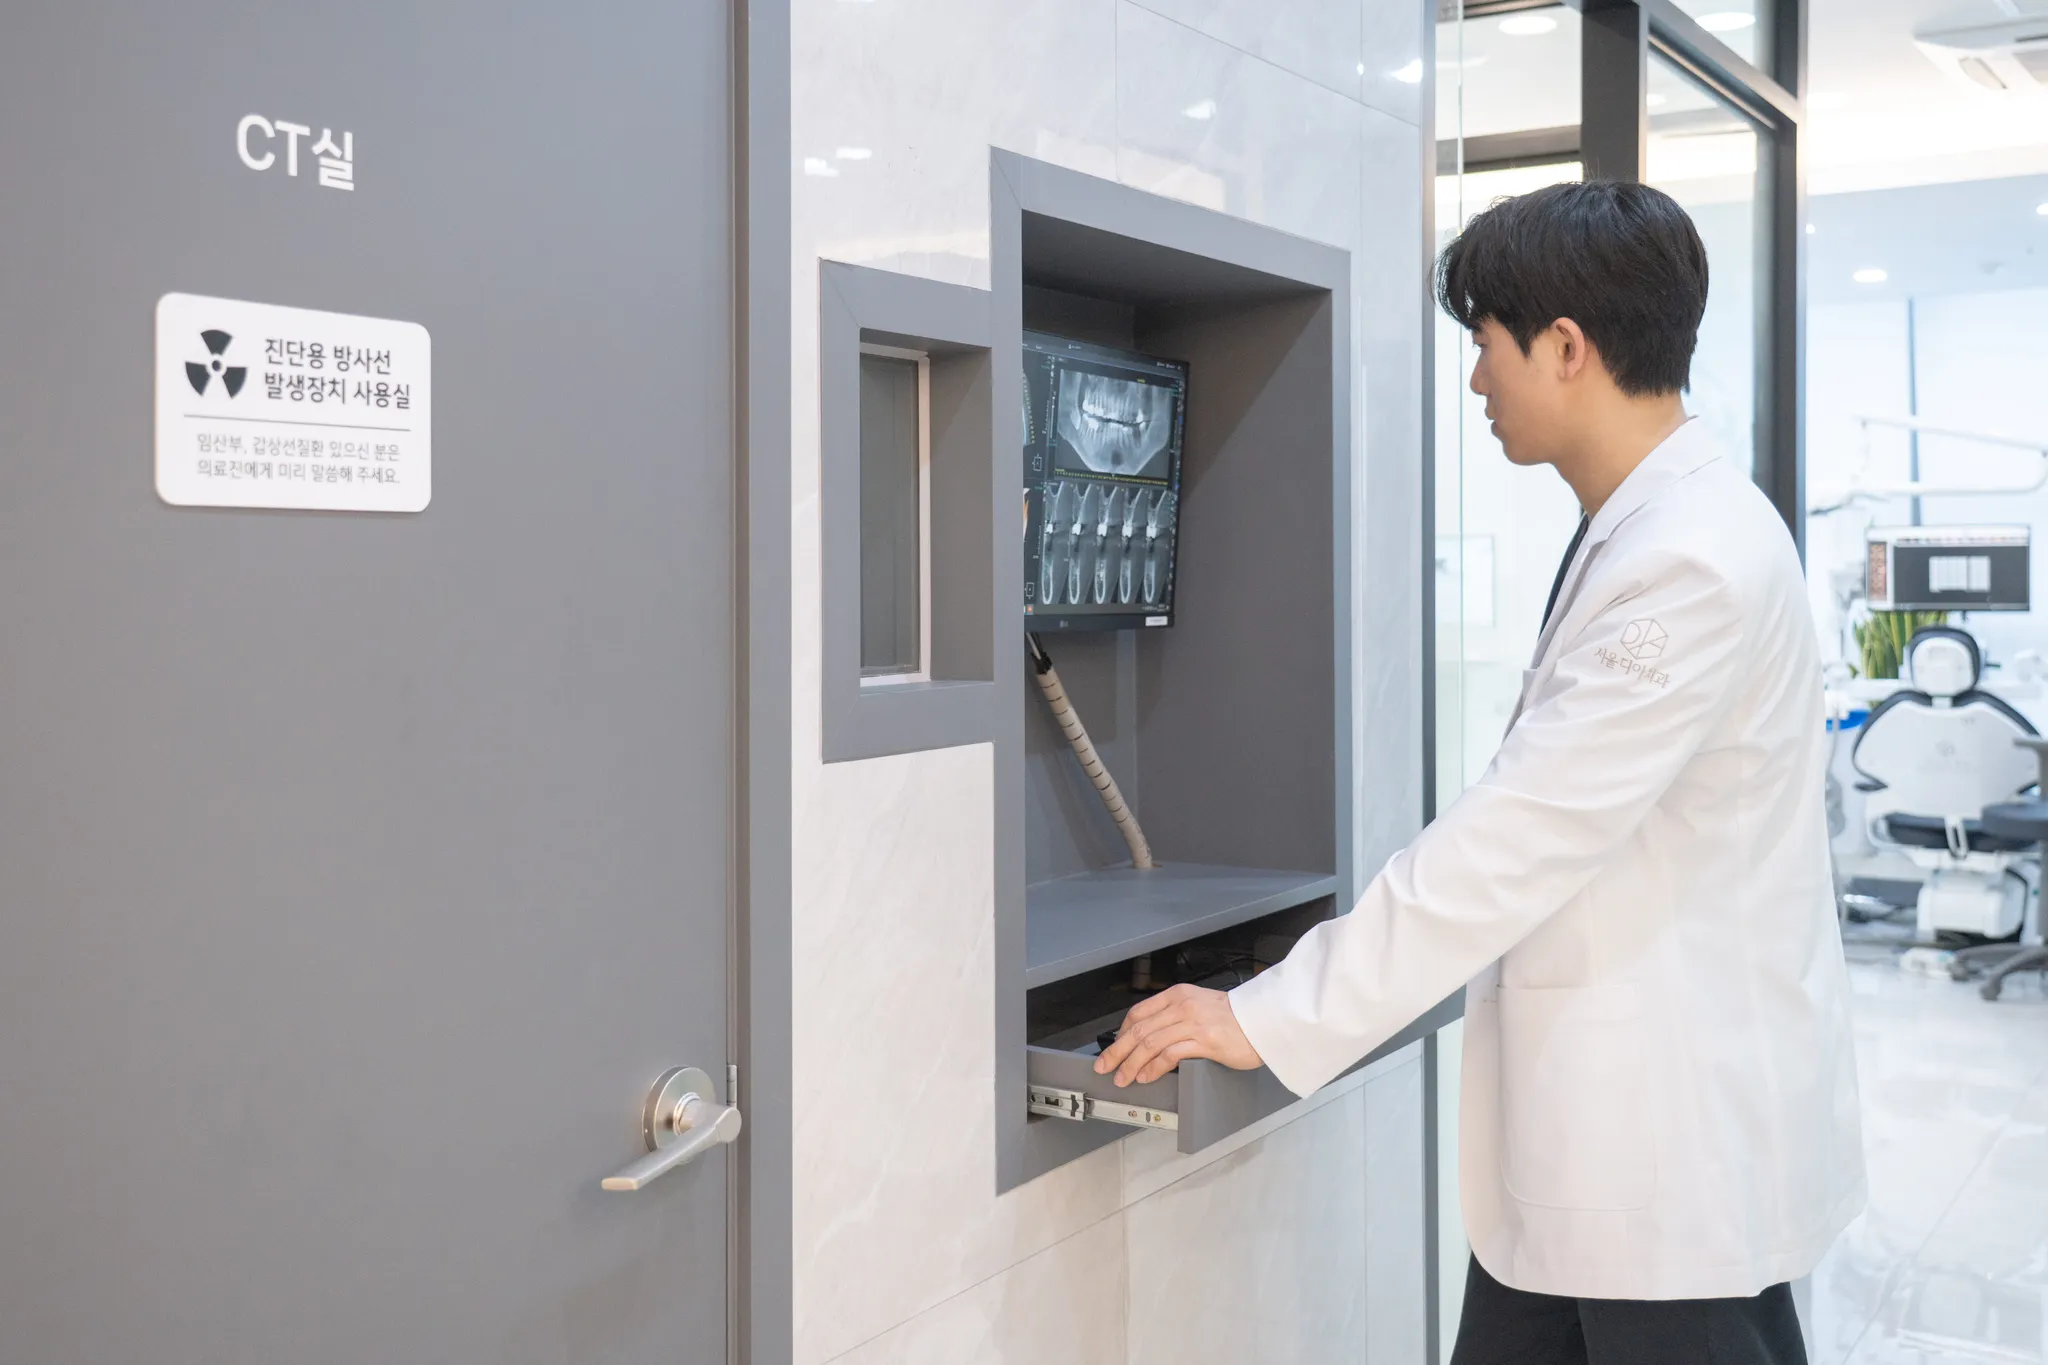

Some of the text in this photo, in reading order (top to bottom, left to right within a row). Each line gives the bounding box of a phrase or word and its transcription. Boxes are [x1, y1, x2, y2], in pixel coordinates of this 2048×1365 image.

[236, 113, 355, 191] CT실
[265, 338, 391, 376] 진단용 방사선
[265, 372, 411, 410] 발생장치 사용실
[197, 433, 401, 462] 임산부, 갑상선질환 있으신 분은
[197, 459, 401, 485] 의료진에게 미리 말씀해 주세요.
